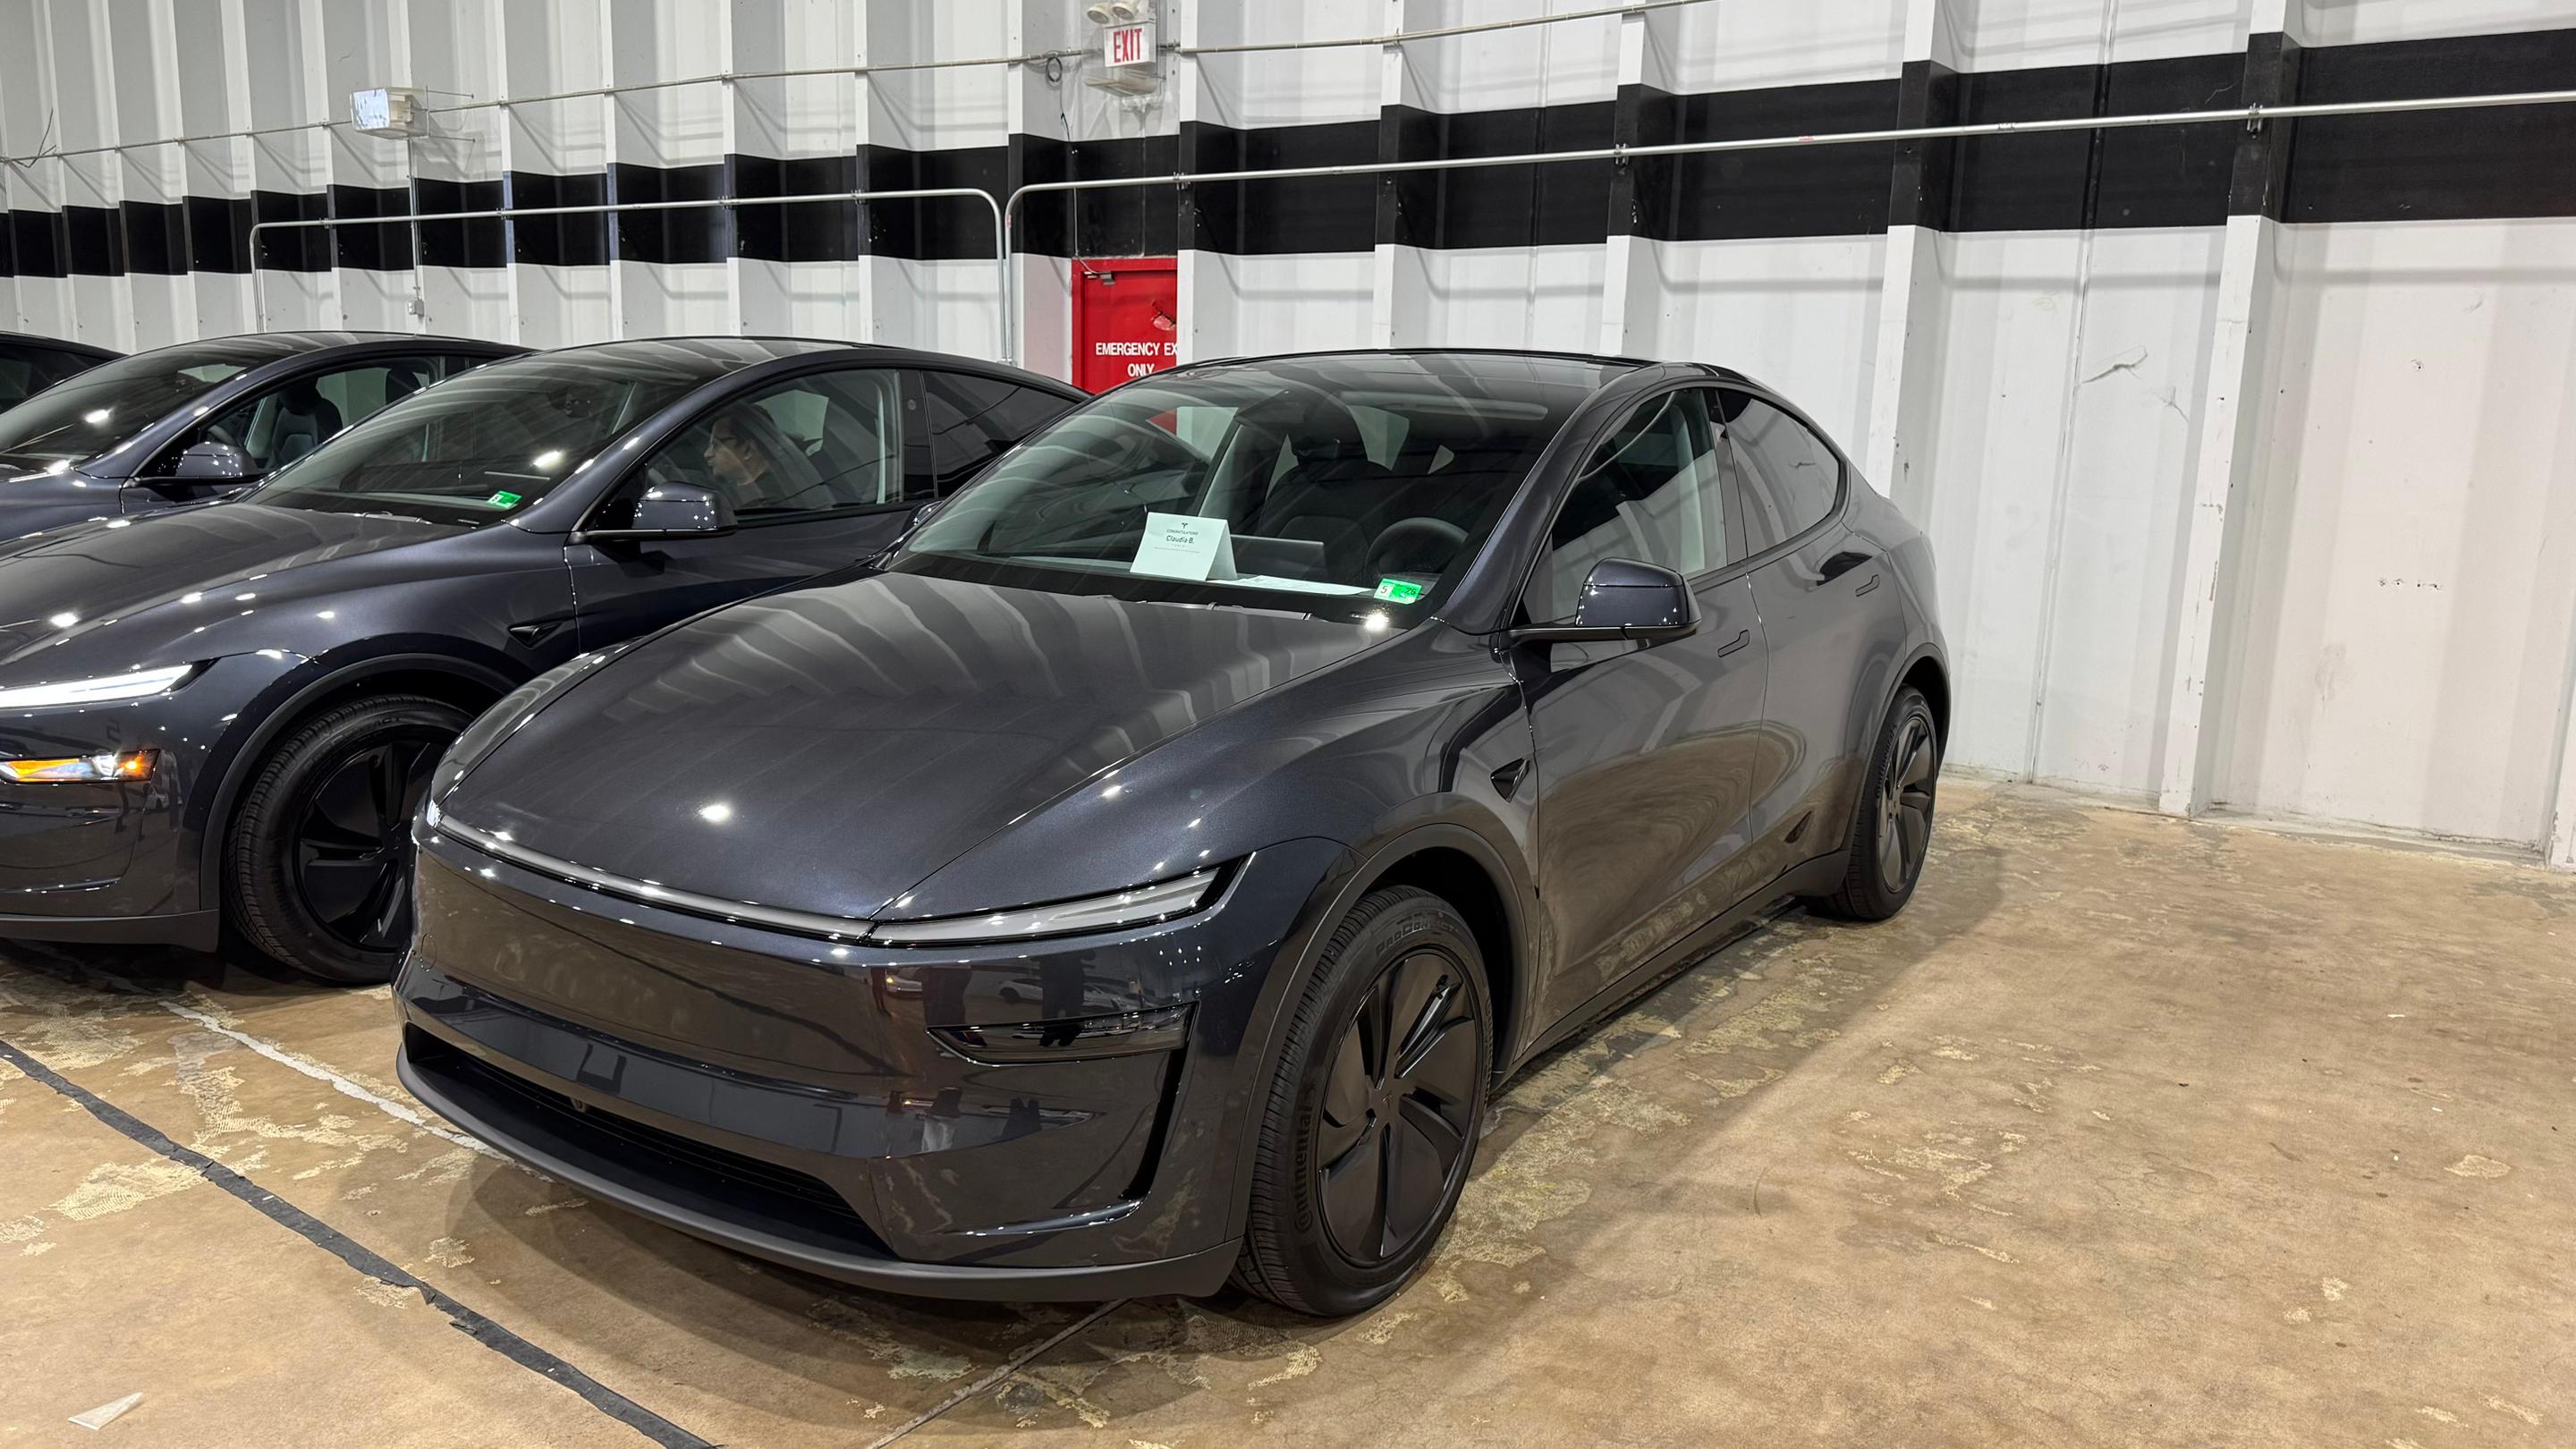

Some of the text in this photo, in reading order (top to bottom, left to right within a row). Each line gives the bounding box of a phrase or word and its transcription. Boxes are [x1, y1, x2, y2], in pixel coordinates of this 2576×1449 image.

[1114, 28, 1142, 63] EXIT
[1096, 342, 1161, 356] EMERGENCY
[1127, 363, 1155, 377] ONLY
[1380, 585, 1417, 596] 5 26
